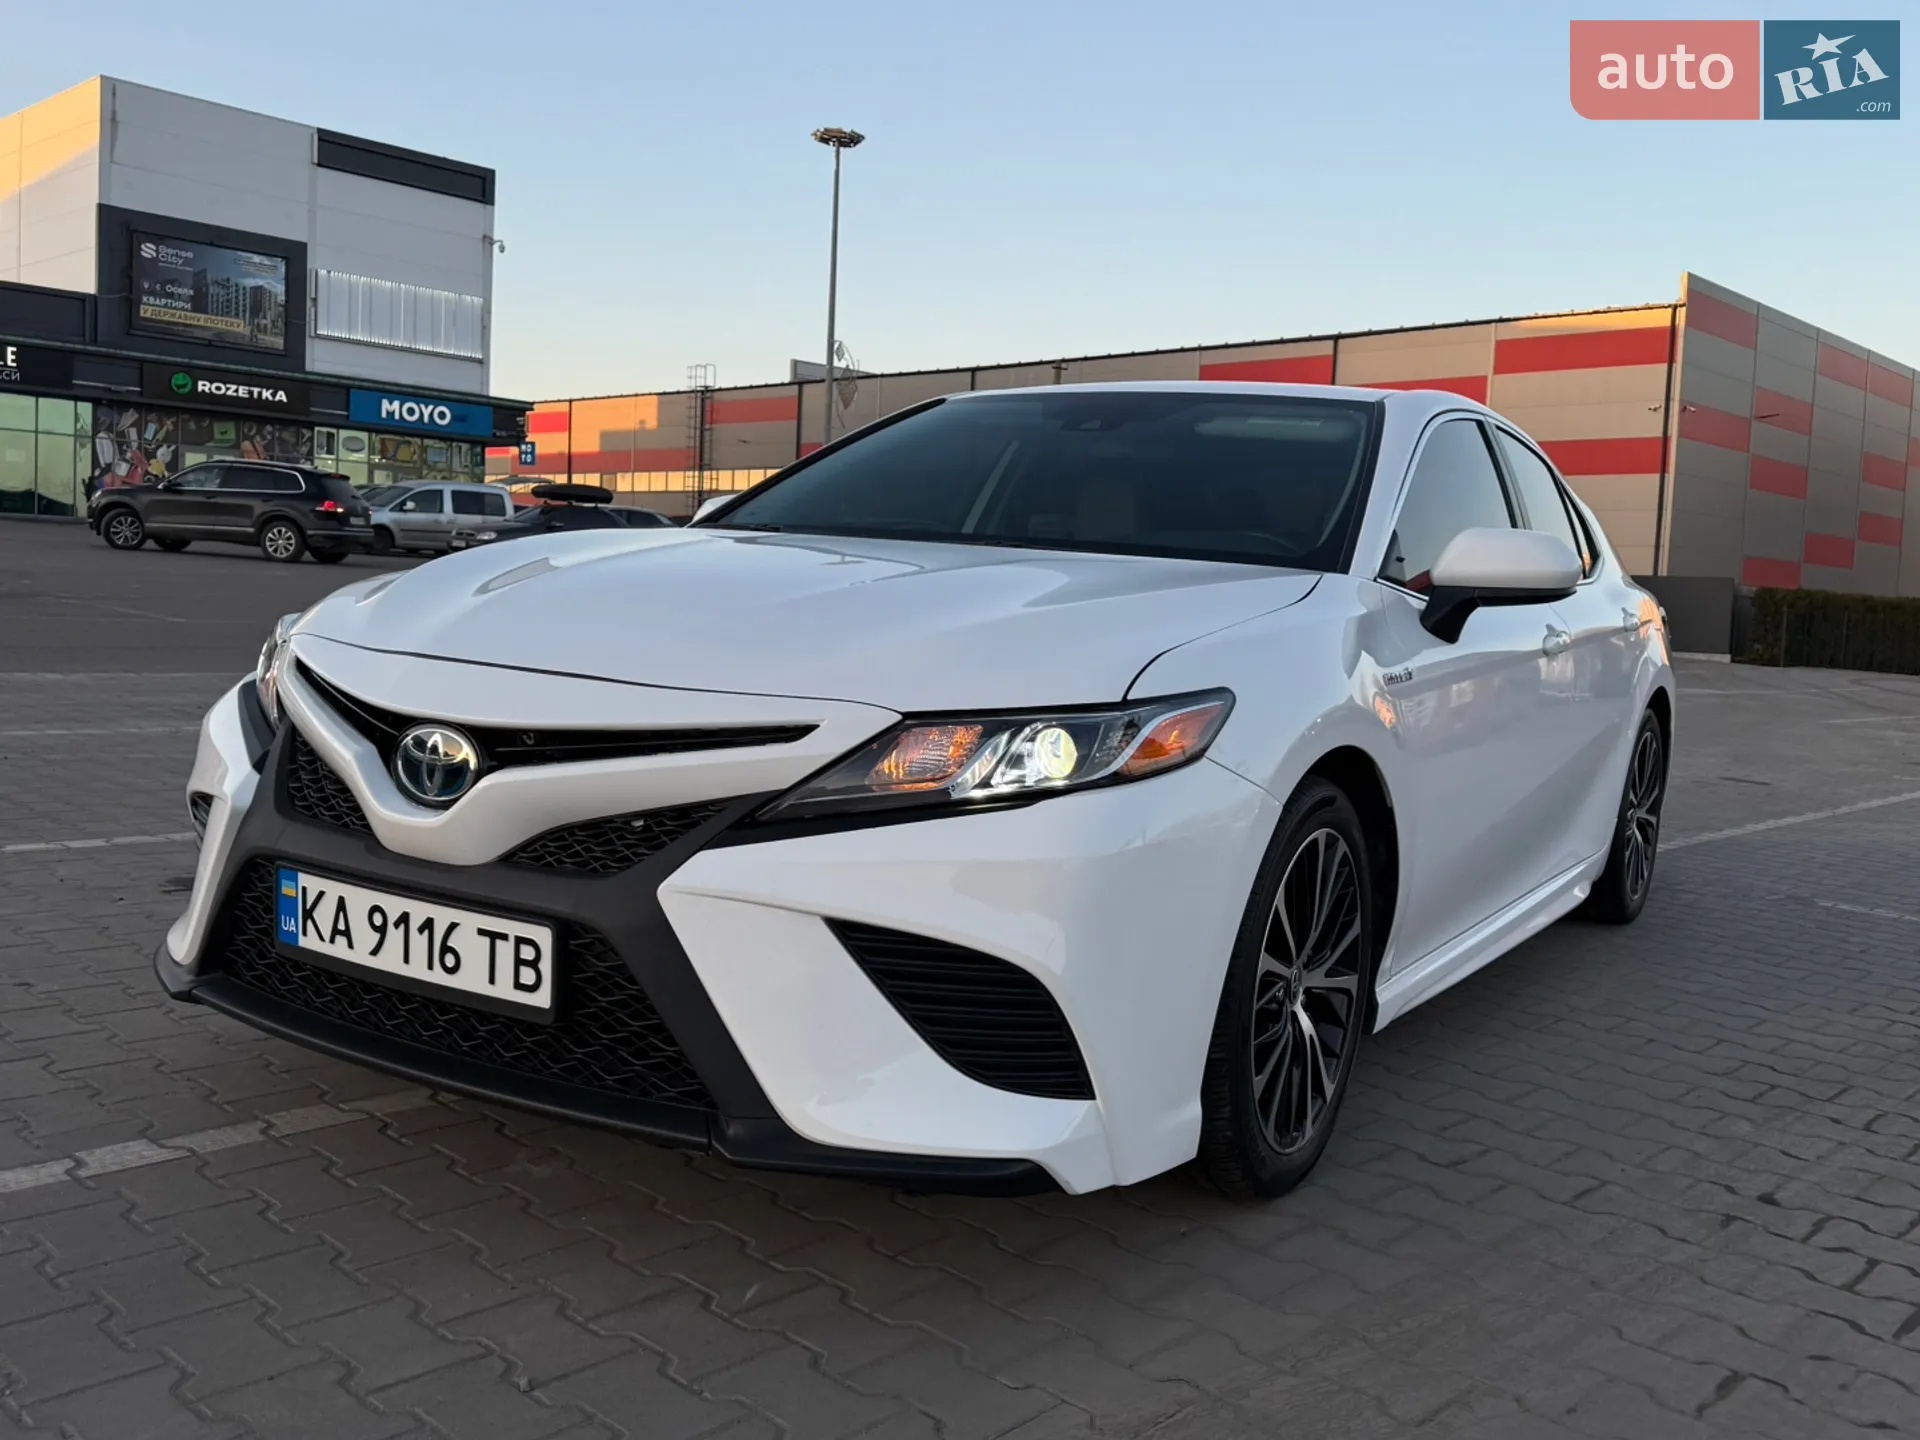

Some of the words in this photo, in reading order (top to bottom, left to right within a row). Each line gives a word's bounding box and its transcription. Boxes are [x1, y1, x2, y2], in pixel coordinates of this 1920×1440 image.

[158, 253, 184, 265] City
[142, 295, 192, 311] КВАРТИРИ
[142, 307, 150, 317] У
[150, 308, 201, 323] ДЕРЖАВНУ
[203, 316, 242, 329] ІПОТЕКУ
[0, 346, 17, 367] E
[197, 380, 288, 403] ROZETKA
[381, 398, 452, 426] MOYO
[281, 915, 297, 934] UA
[301, 885, 354, 950] KA
[367, 903, 462, 976] 9116
[476, 927, 543, 994] TB
